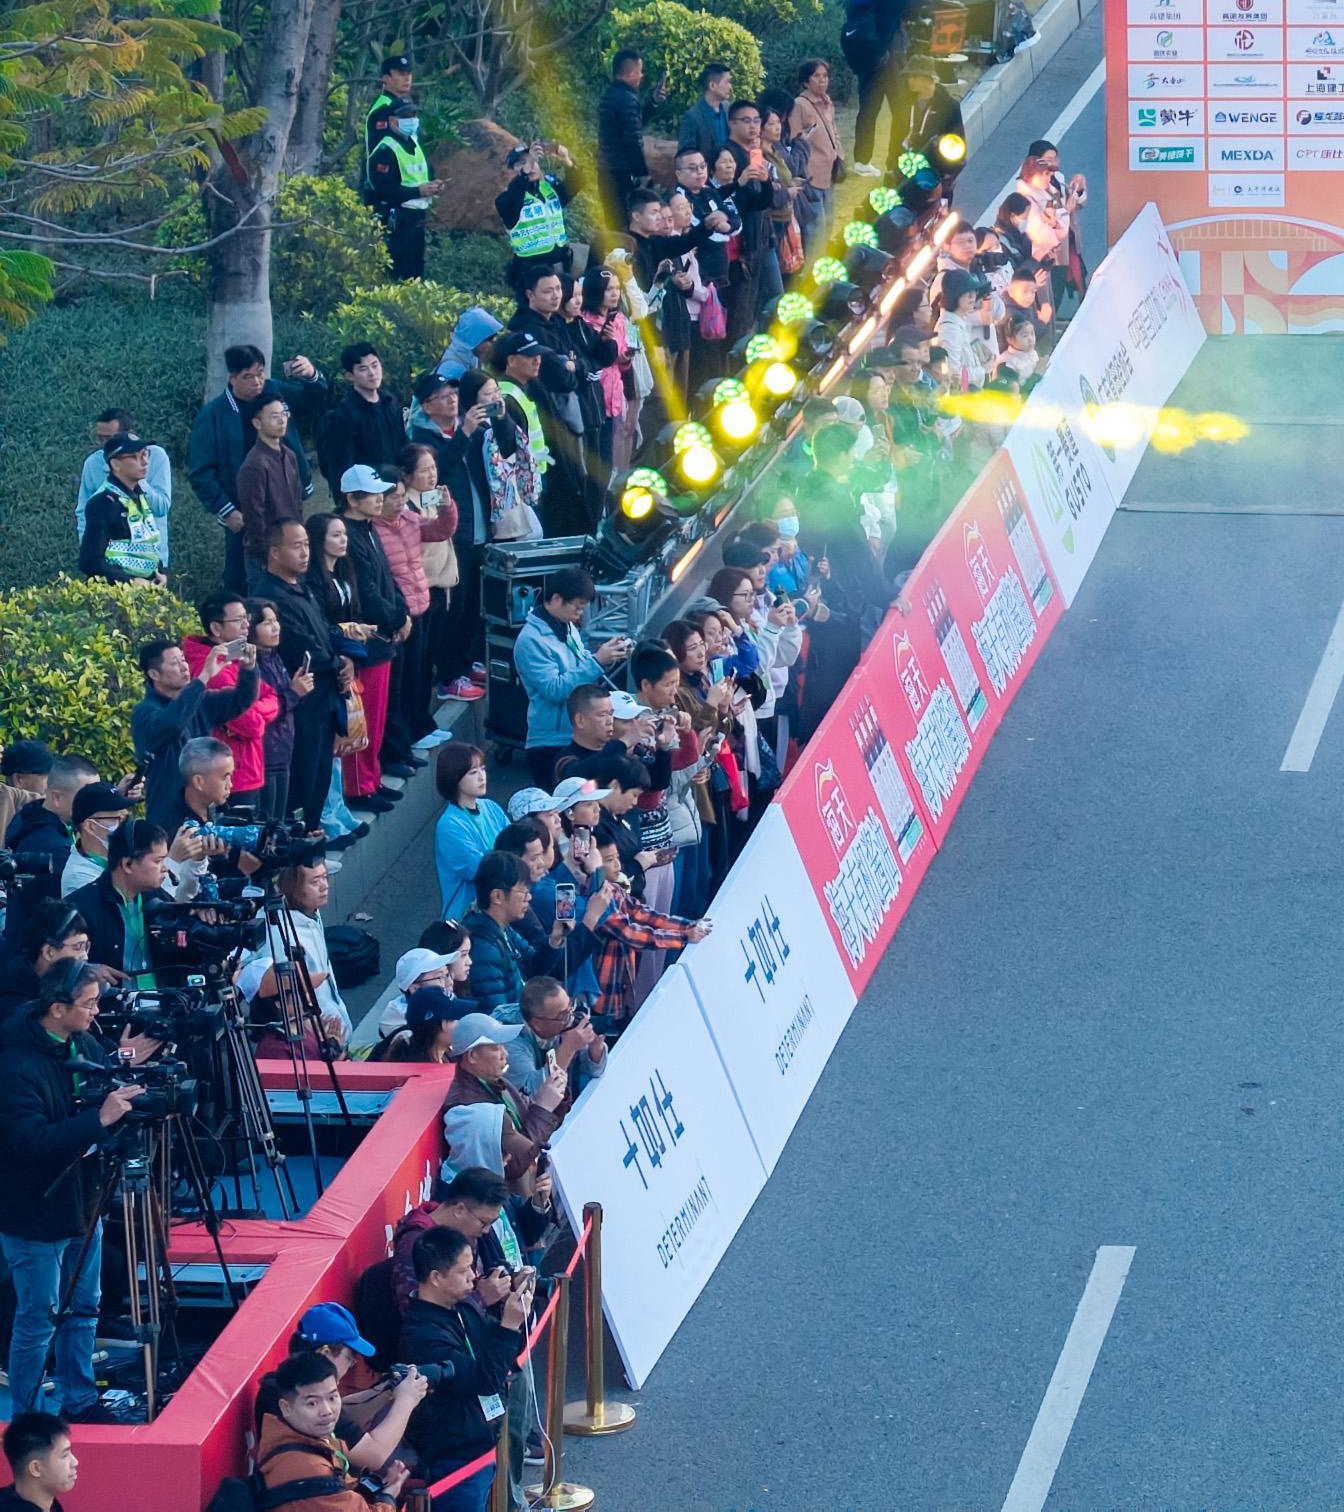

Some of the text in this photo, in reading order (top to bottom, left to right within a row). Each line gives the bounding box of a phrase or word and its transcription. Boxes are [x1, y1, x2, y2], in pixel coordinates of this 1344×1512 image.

[1160, 109, 1195, 127] 蒙牛
[1229, 112, 1278, 123] WENGE
[1221, 149, 1274, 161] MEXDA
[1065, 462, 1092, 521] GUSTO
[971, 548, 994, 599] 海天
[900, 656, 929, 714] 海天
[822, 786, 855, 853] 海天
[774, 993, 816, 1078] DETERMINANT
[657, 1175, 715, 1271] DETERMINANT
